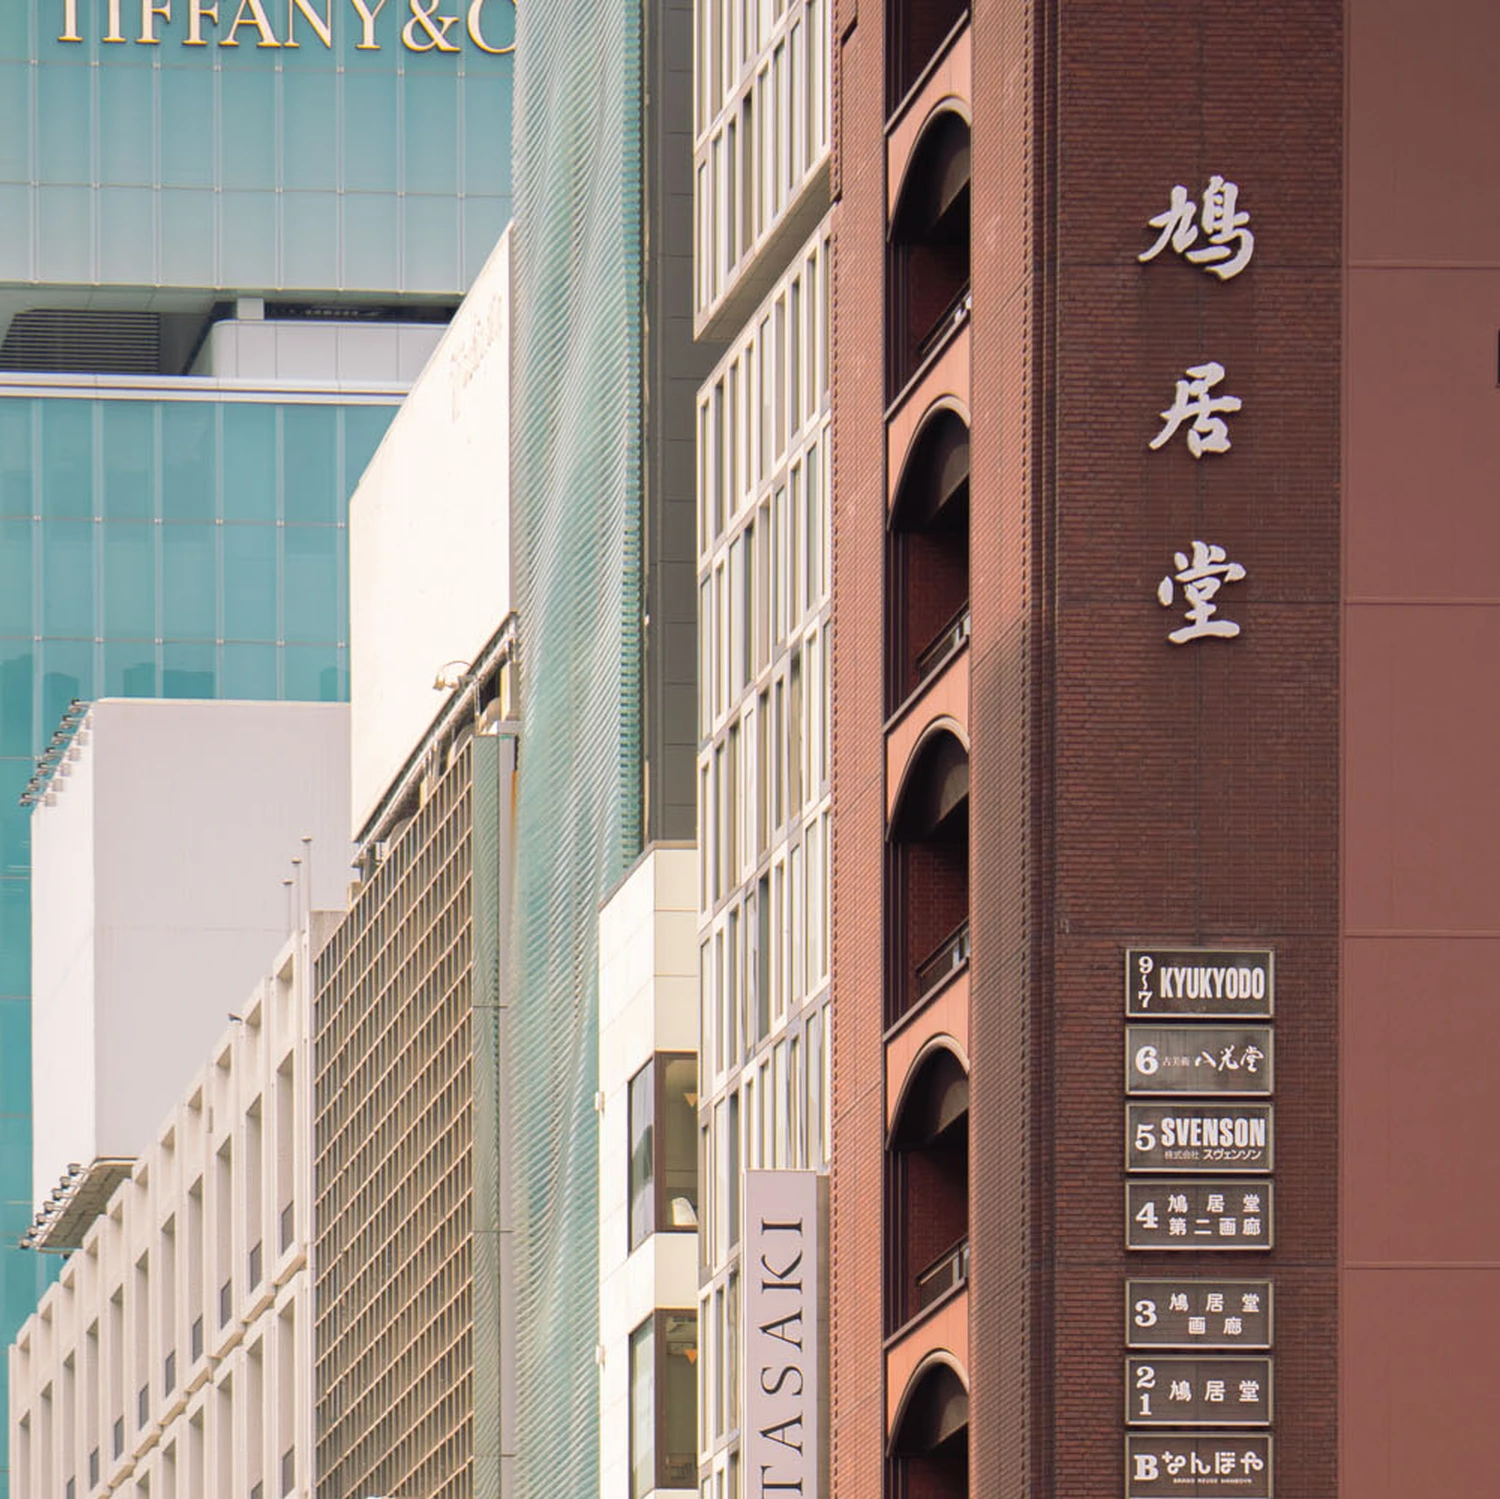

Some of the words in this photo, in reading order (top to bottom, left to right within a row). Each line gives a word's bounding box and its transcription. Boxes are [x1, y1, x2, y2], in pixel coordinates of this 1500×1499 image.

[1137, 174, 1255, 644] 鳩居堂
[1160, 967, 1265, 999] KYUKYODO
[1135, 1046, 1159, 1074] 6
[1135, 1124, 1156, 1151] 5
[1161, 1118, 1265, 1147] SVENSON
[1136, 1203, 1158, 1229] 4
[1167, 1194, 1260, 1213] 鳩居堂
[1168, 1218, 1261, 1236] 第二画廊
[1135, 1301, 1157, 1327] 3
[1169, 1293, 1260, 1312] 鳩居堂
[1189, 1317, 1242, 1335] 画廊
[1136, 1366, 1156, 1388] 2
[1139, 1393, 1152, 1415] 1
[1168, 1380, 1260, 1402] 鳩居堂
[1133, 1454, 1159, 1480] B
